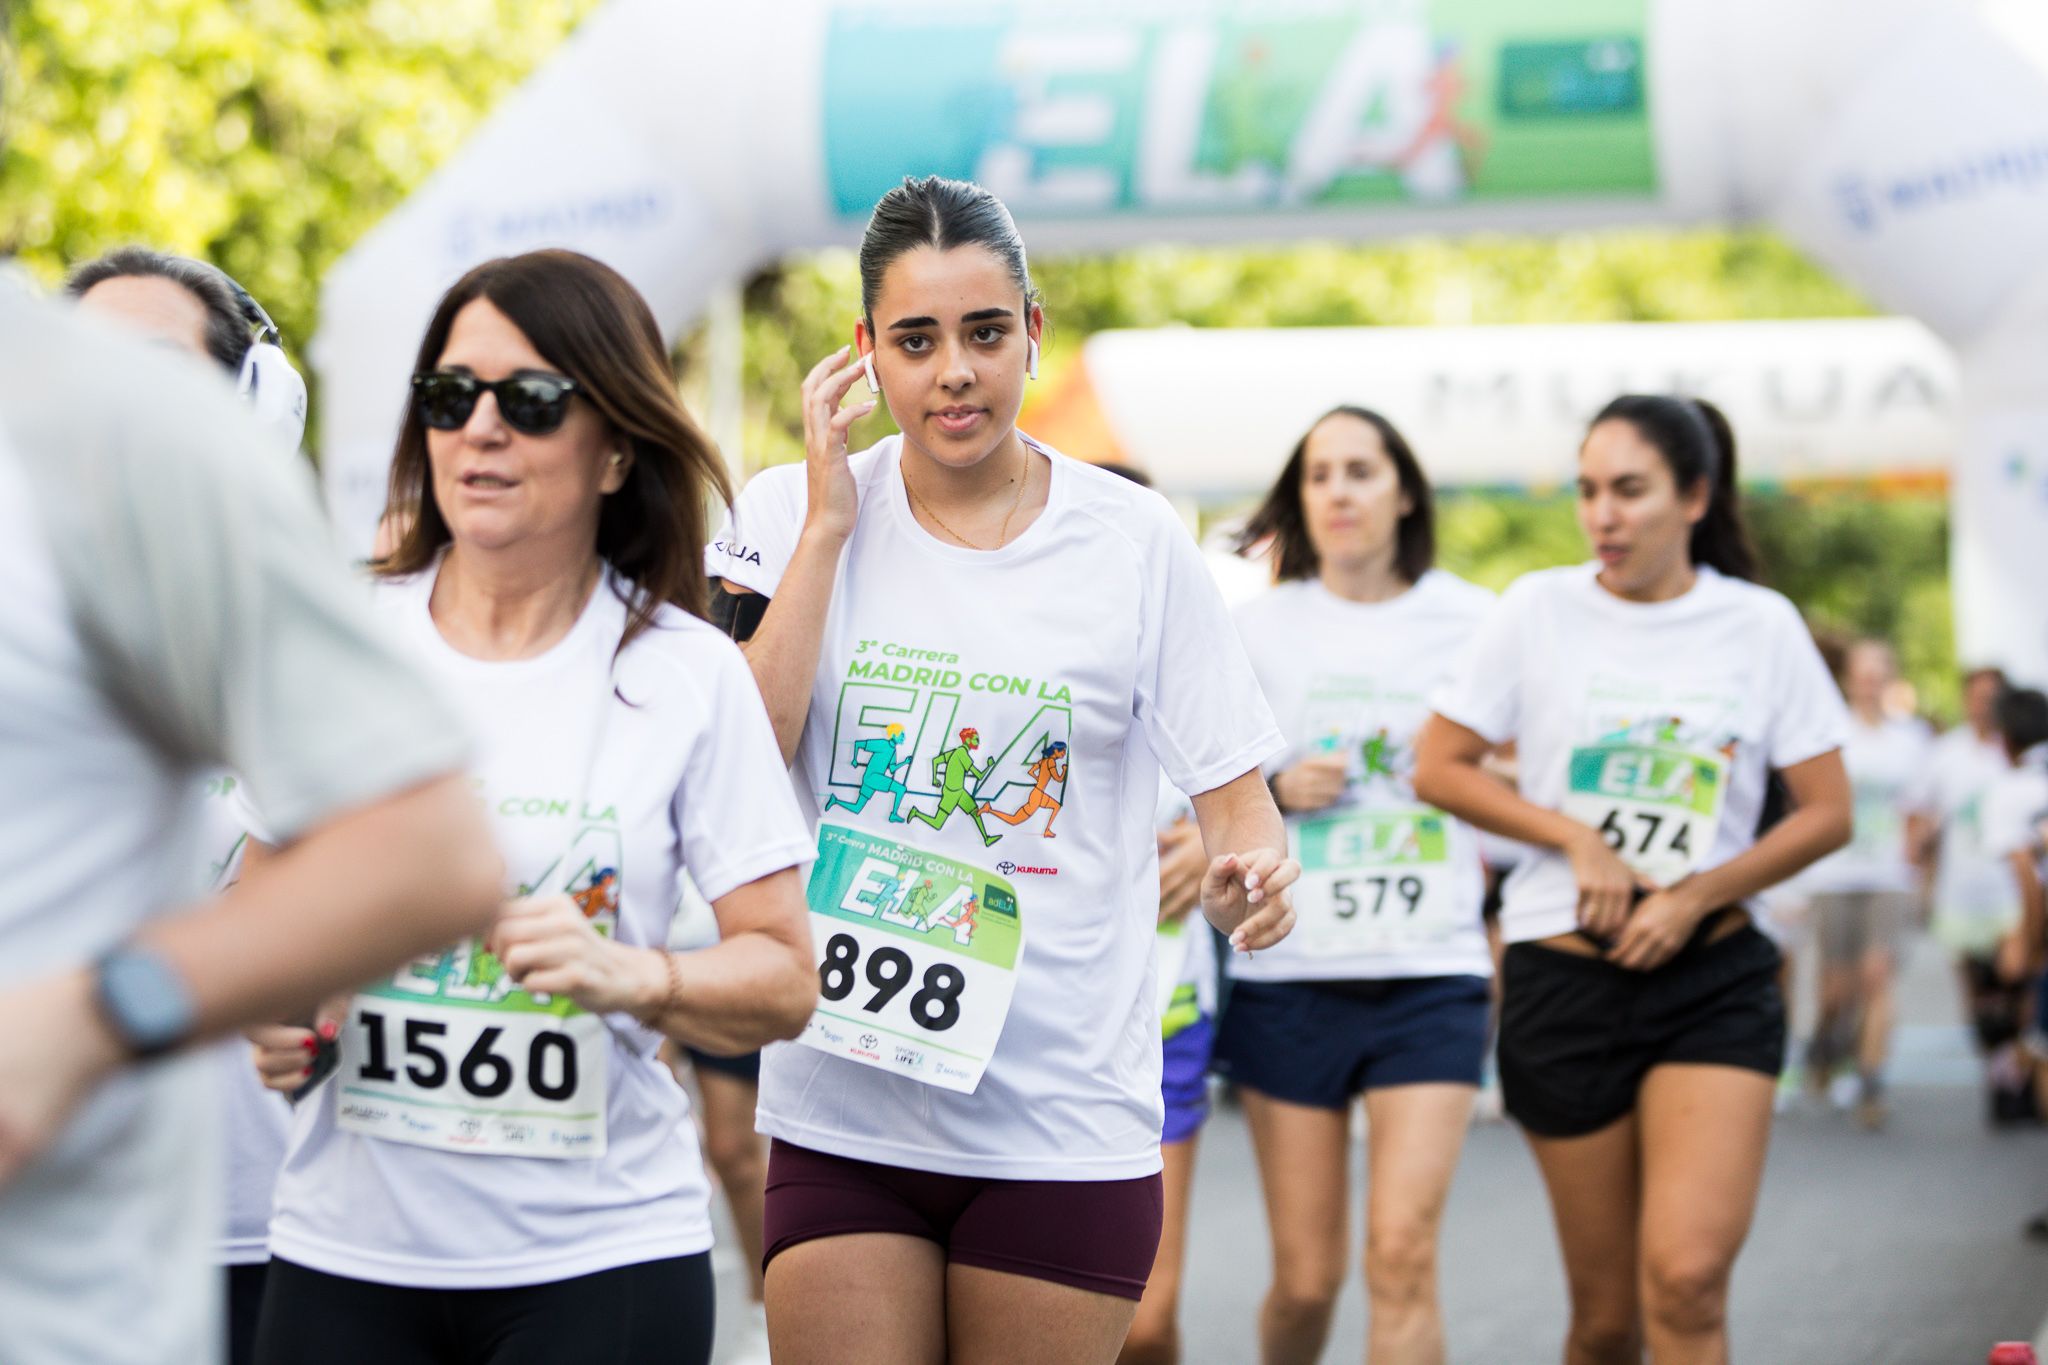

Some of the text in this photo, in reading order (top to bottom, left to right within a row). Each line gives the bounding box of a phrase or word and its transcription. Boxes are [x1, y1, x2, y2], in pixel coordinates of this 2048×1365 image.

[976, 18, 1475, 202] ELA
[882, 642, 959, 664] Carrera
[847, 660, 1072, 704] MADRID CON LA
[828, 682, 1072, 807] ELA
[1602, 751, 1696, 810] ELA
[499, 798, 618, 821] CON LA
[1601, 809, 1691, 859] 674
[868, 843, 923, 868] MADRID
[926, 860, 955, 877] CON
[958, 870, 974, 884] LA
[1326, 818, 1422, 865] ELA
[839, 856, 974, 946] ELA
[1332, 875, 1425, 920] 579
[819, 933, 966, 1031] 898
[358, 1010, 578, 1101] 1560
